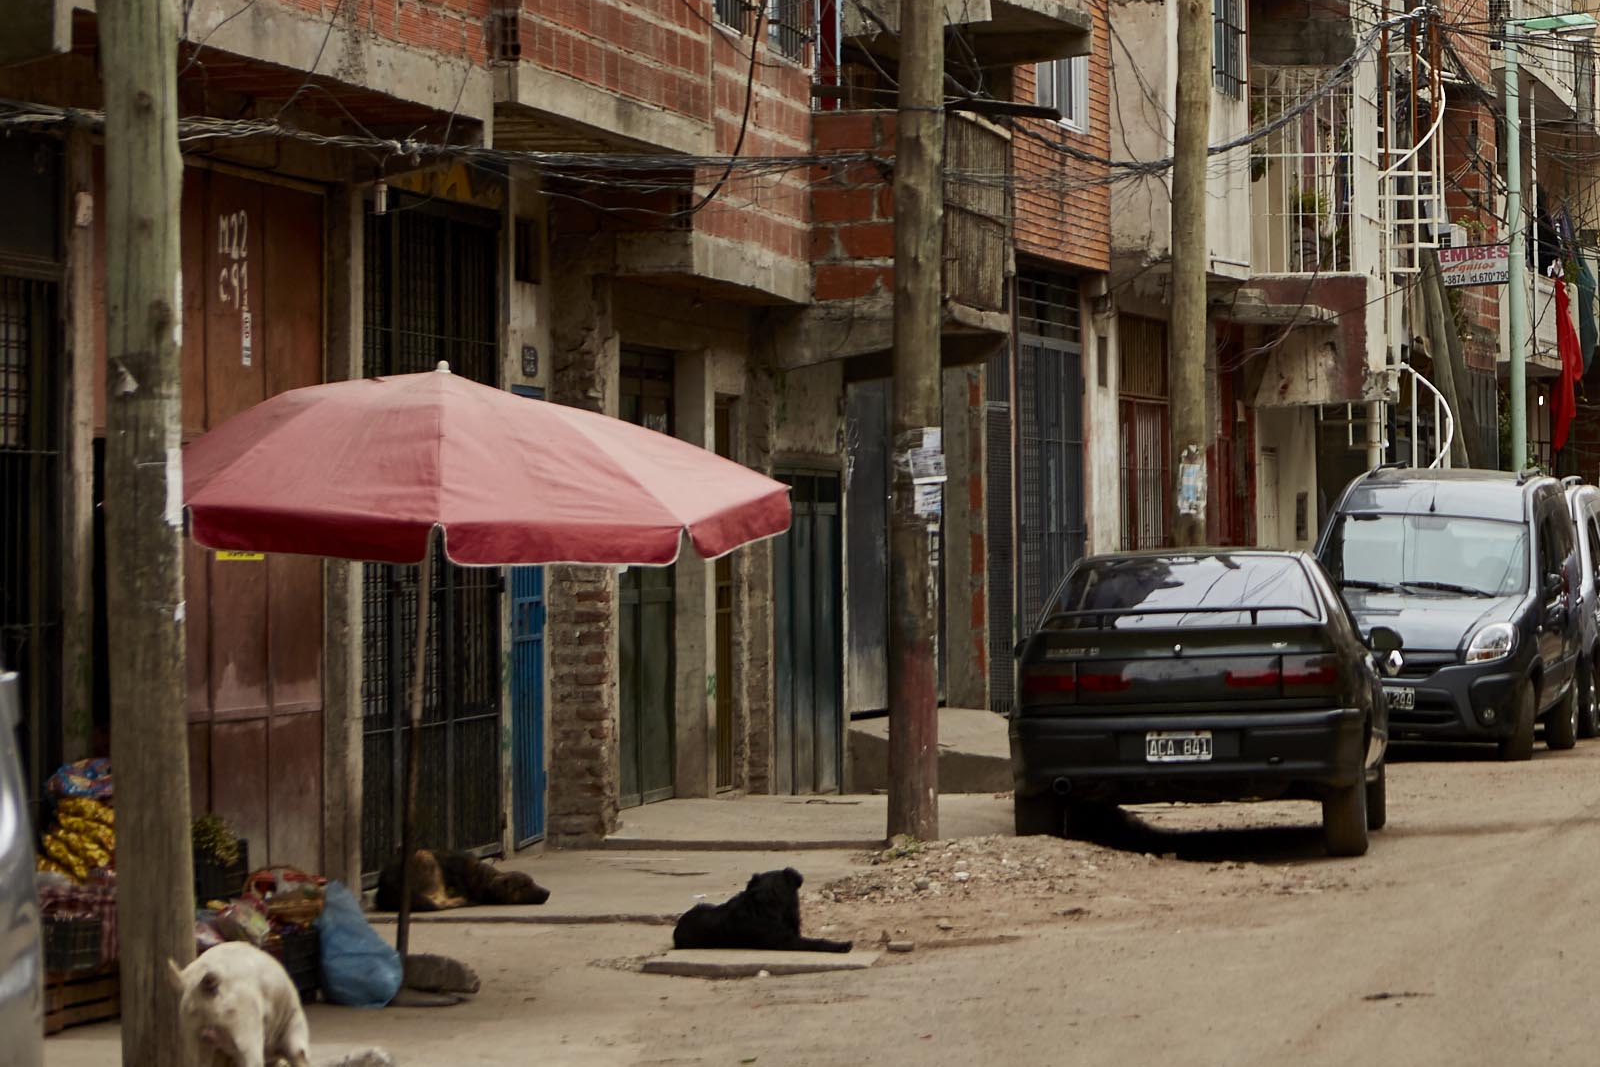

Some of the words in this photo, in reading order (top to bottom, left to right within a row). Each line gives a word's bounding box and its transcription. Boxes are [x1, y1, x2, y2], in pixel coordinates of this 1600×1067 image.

[1440, 245, 1508, 263] EMISES
[1150, 739, 1175, 755] ACA
[1184, 738, 1209, 755] 841
